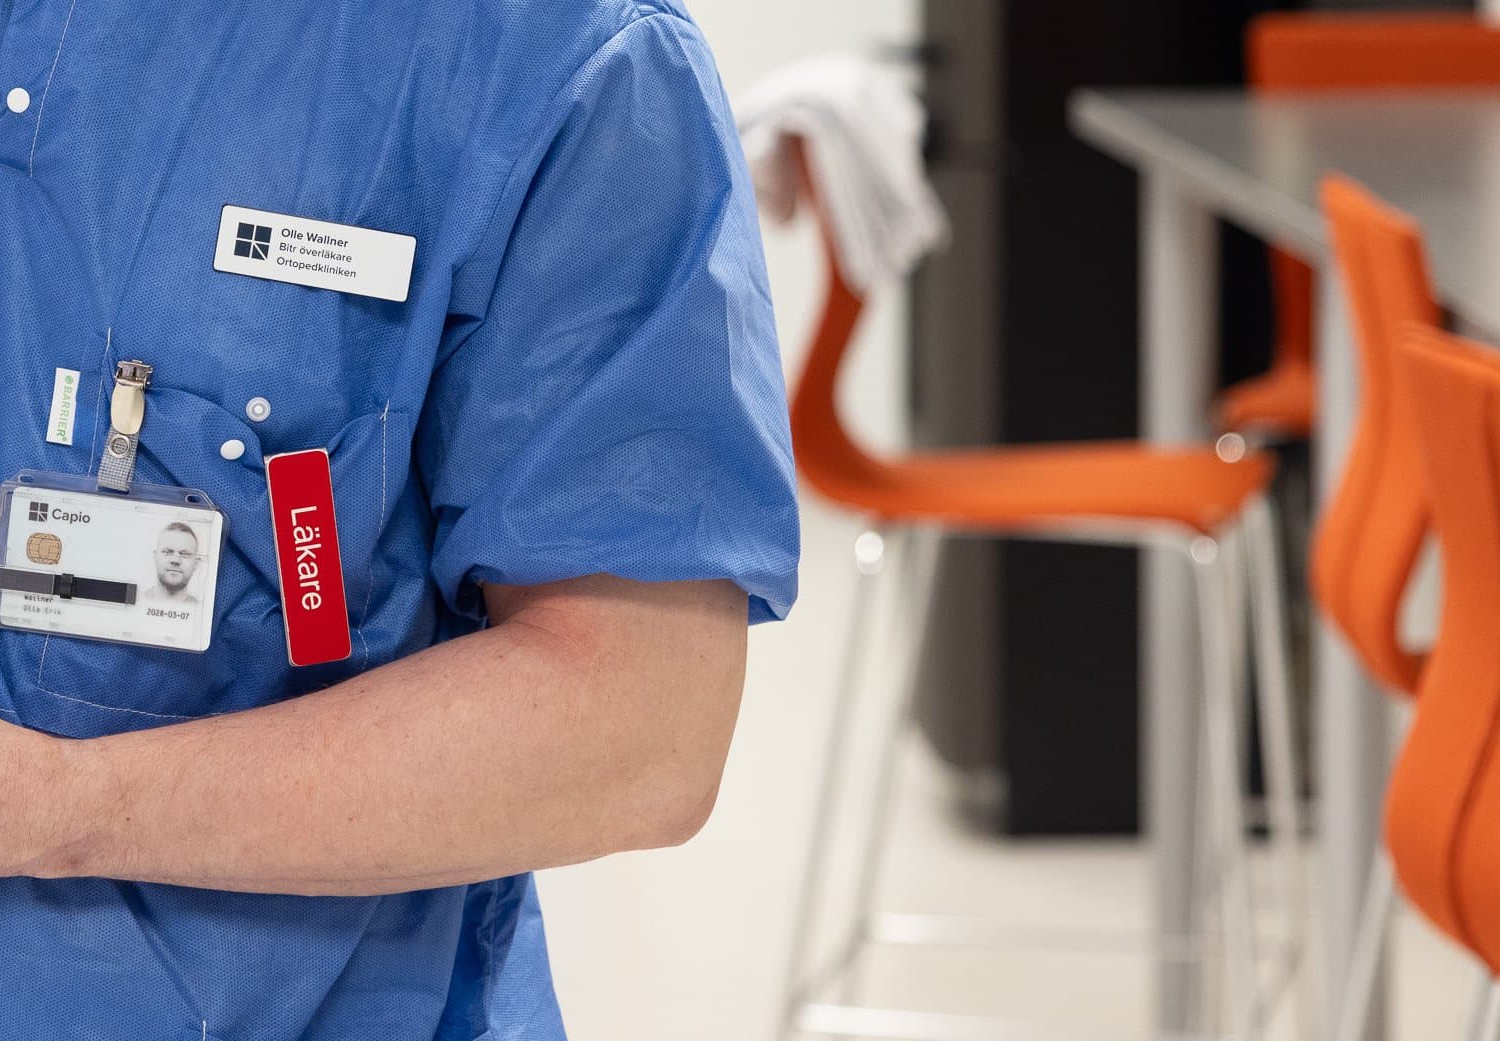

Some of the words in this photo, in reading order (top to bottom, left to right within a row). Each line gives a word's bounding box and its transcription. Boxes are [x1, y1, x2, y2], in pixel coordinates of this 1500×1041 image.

[281, 227, 304, 241] Olle
[306, 232, 349, 248] Wallner
[279, 242, 297, 254] Bitr
[299, 245, 353, 263] överläkare
[276, 257, 357, 278] Ortopedkliniken
[52, 508, 91, 524] Capio
[290, 505, 322, 611] Läkare
